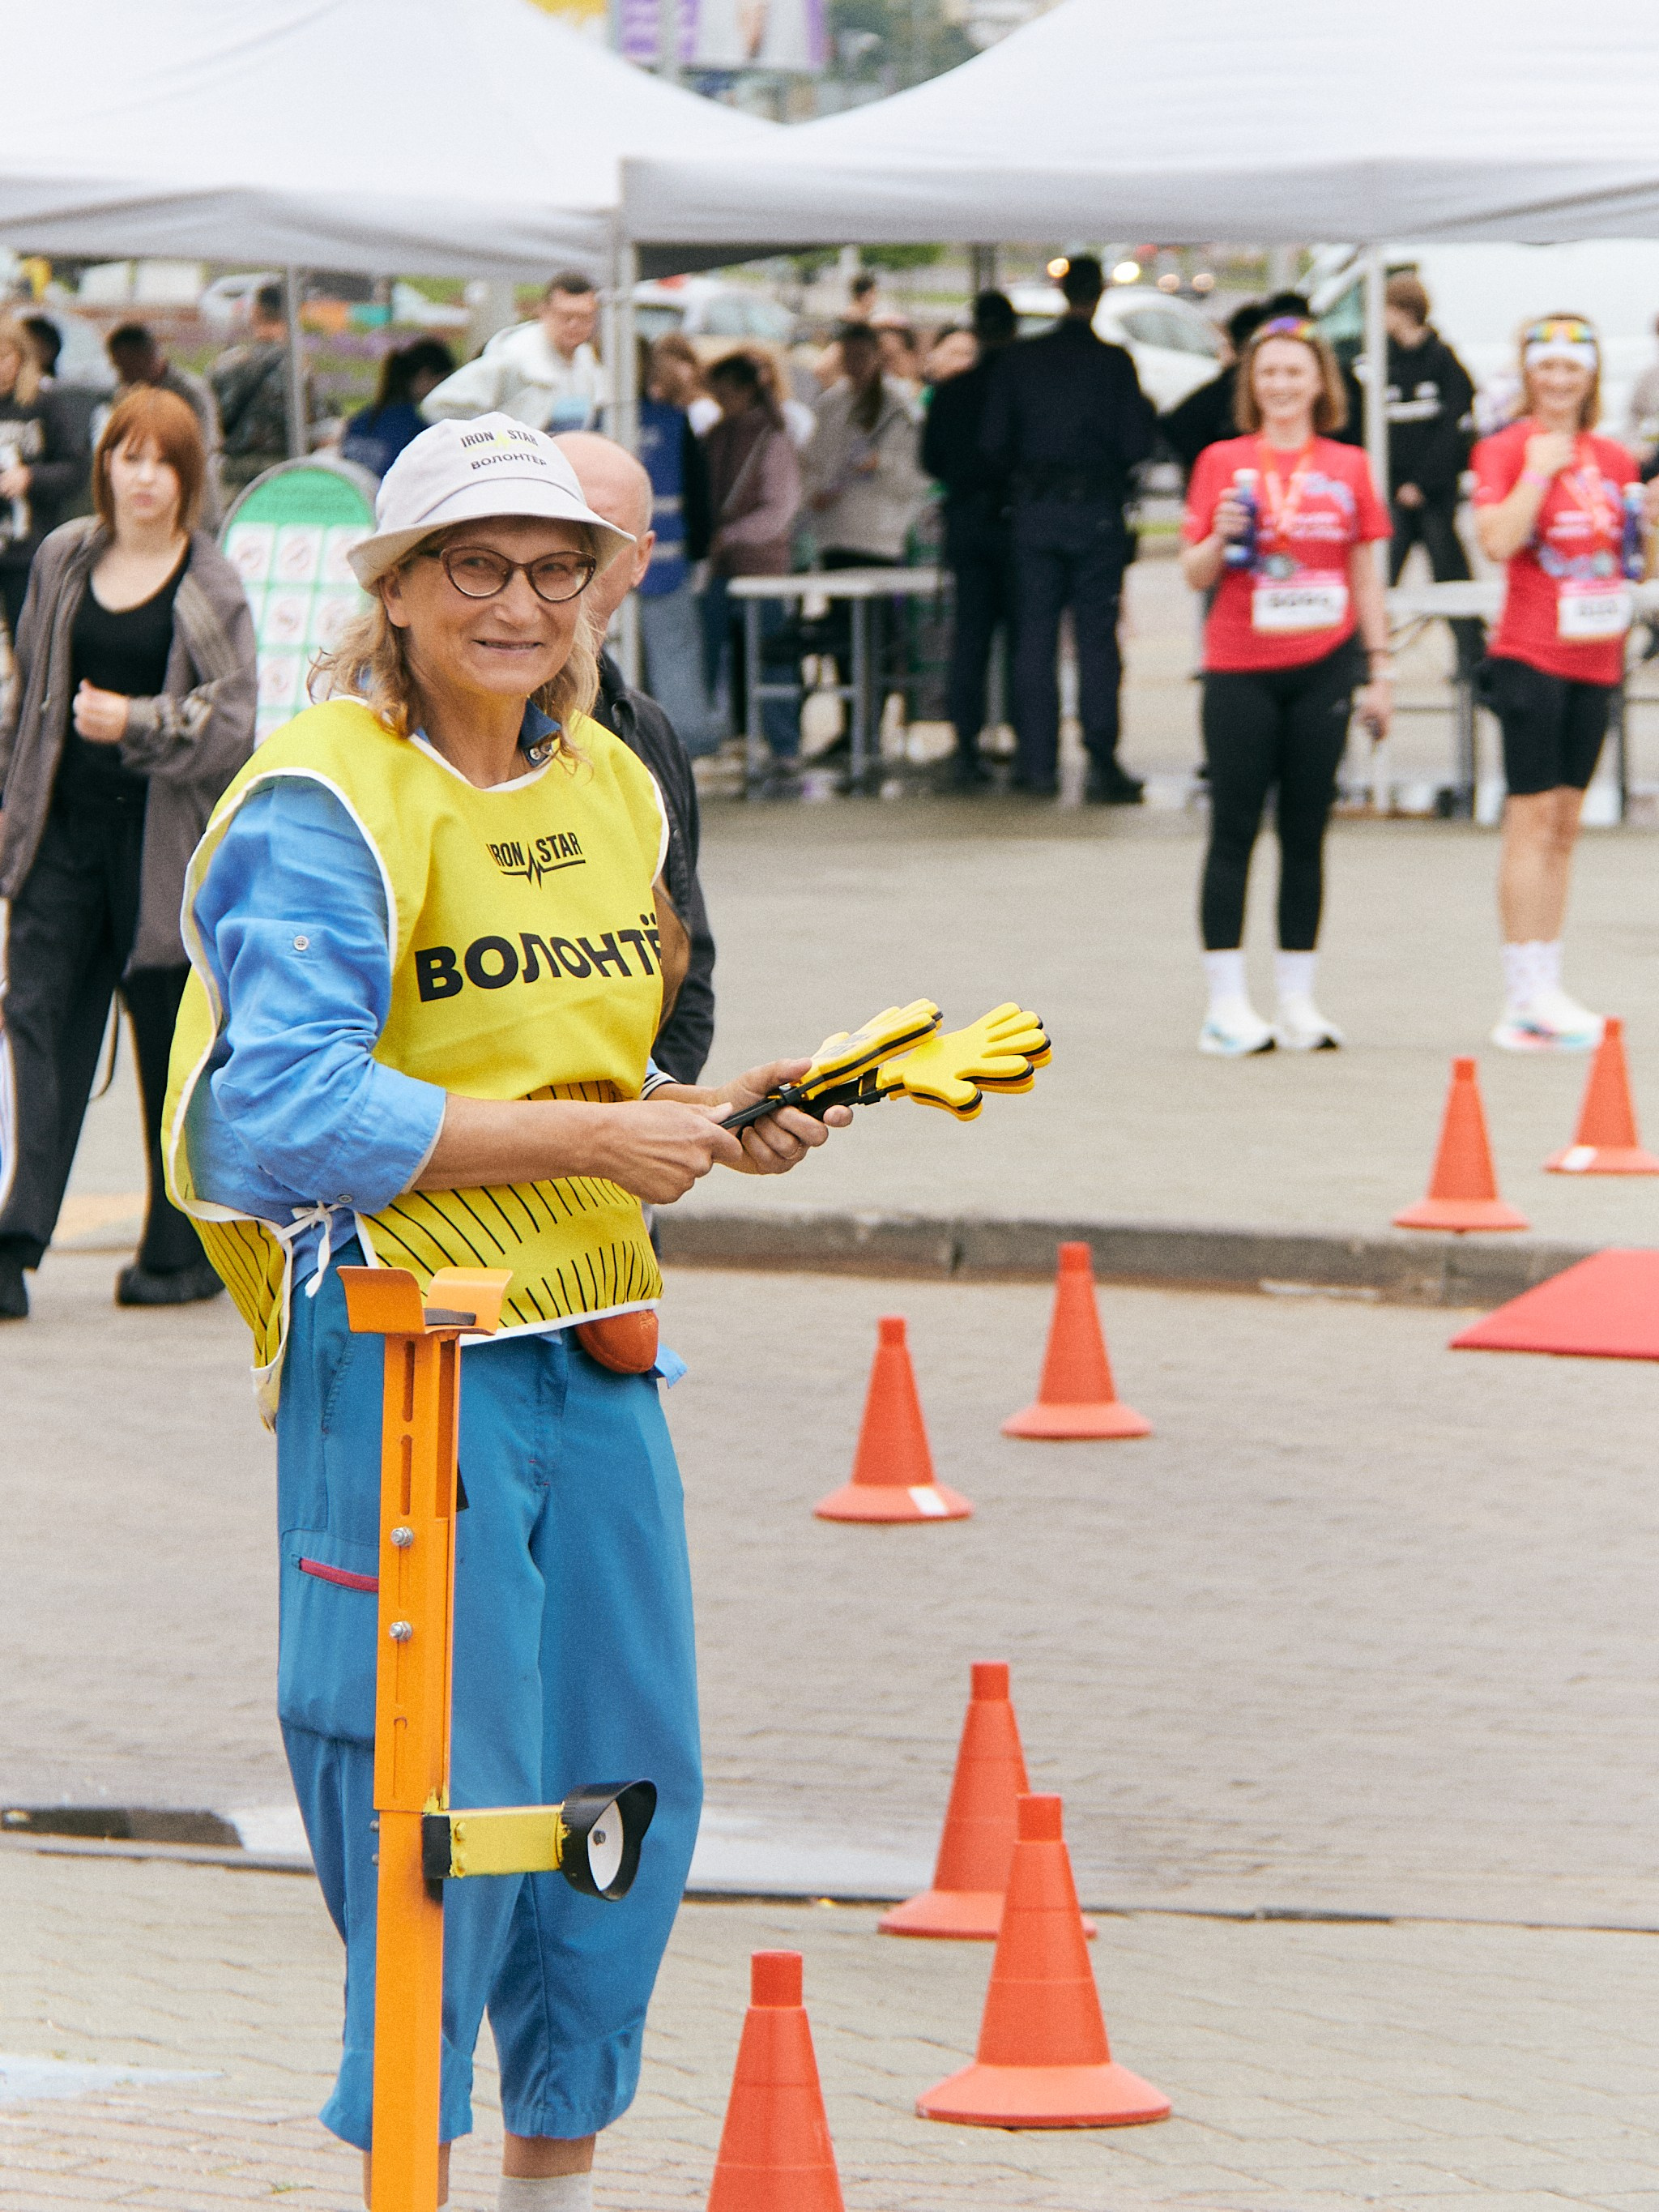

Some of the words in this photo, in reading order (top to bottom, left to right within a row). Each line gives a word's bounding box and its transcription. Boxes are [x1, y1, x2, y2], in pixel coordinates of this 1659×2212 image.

[460, 430, 495, 448] IRON
[506, 429, 539, 446] STAR
[535, 831, 583, 863] STAR
